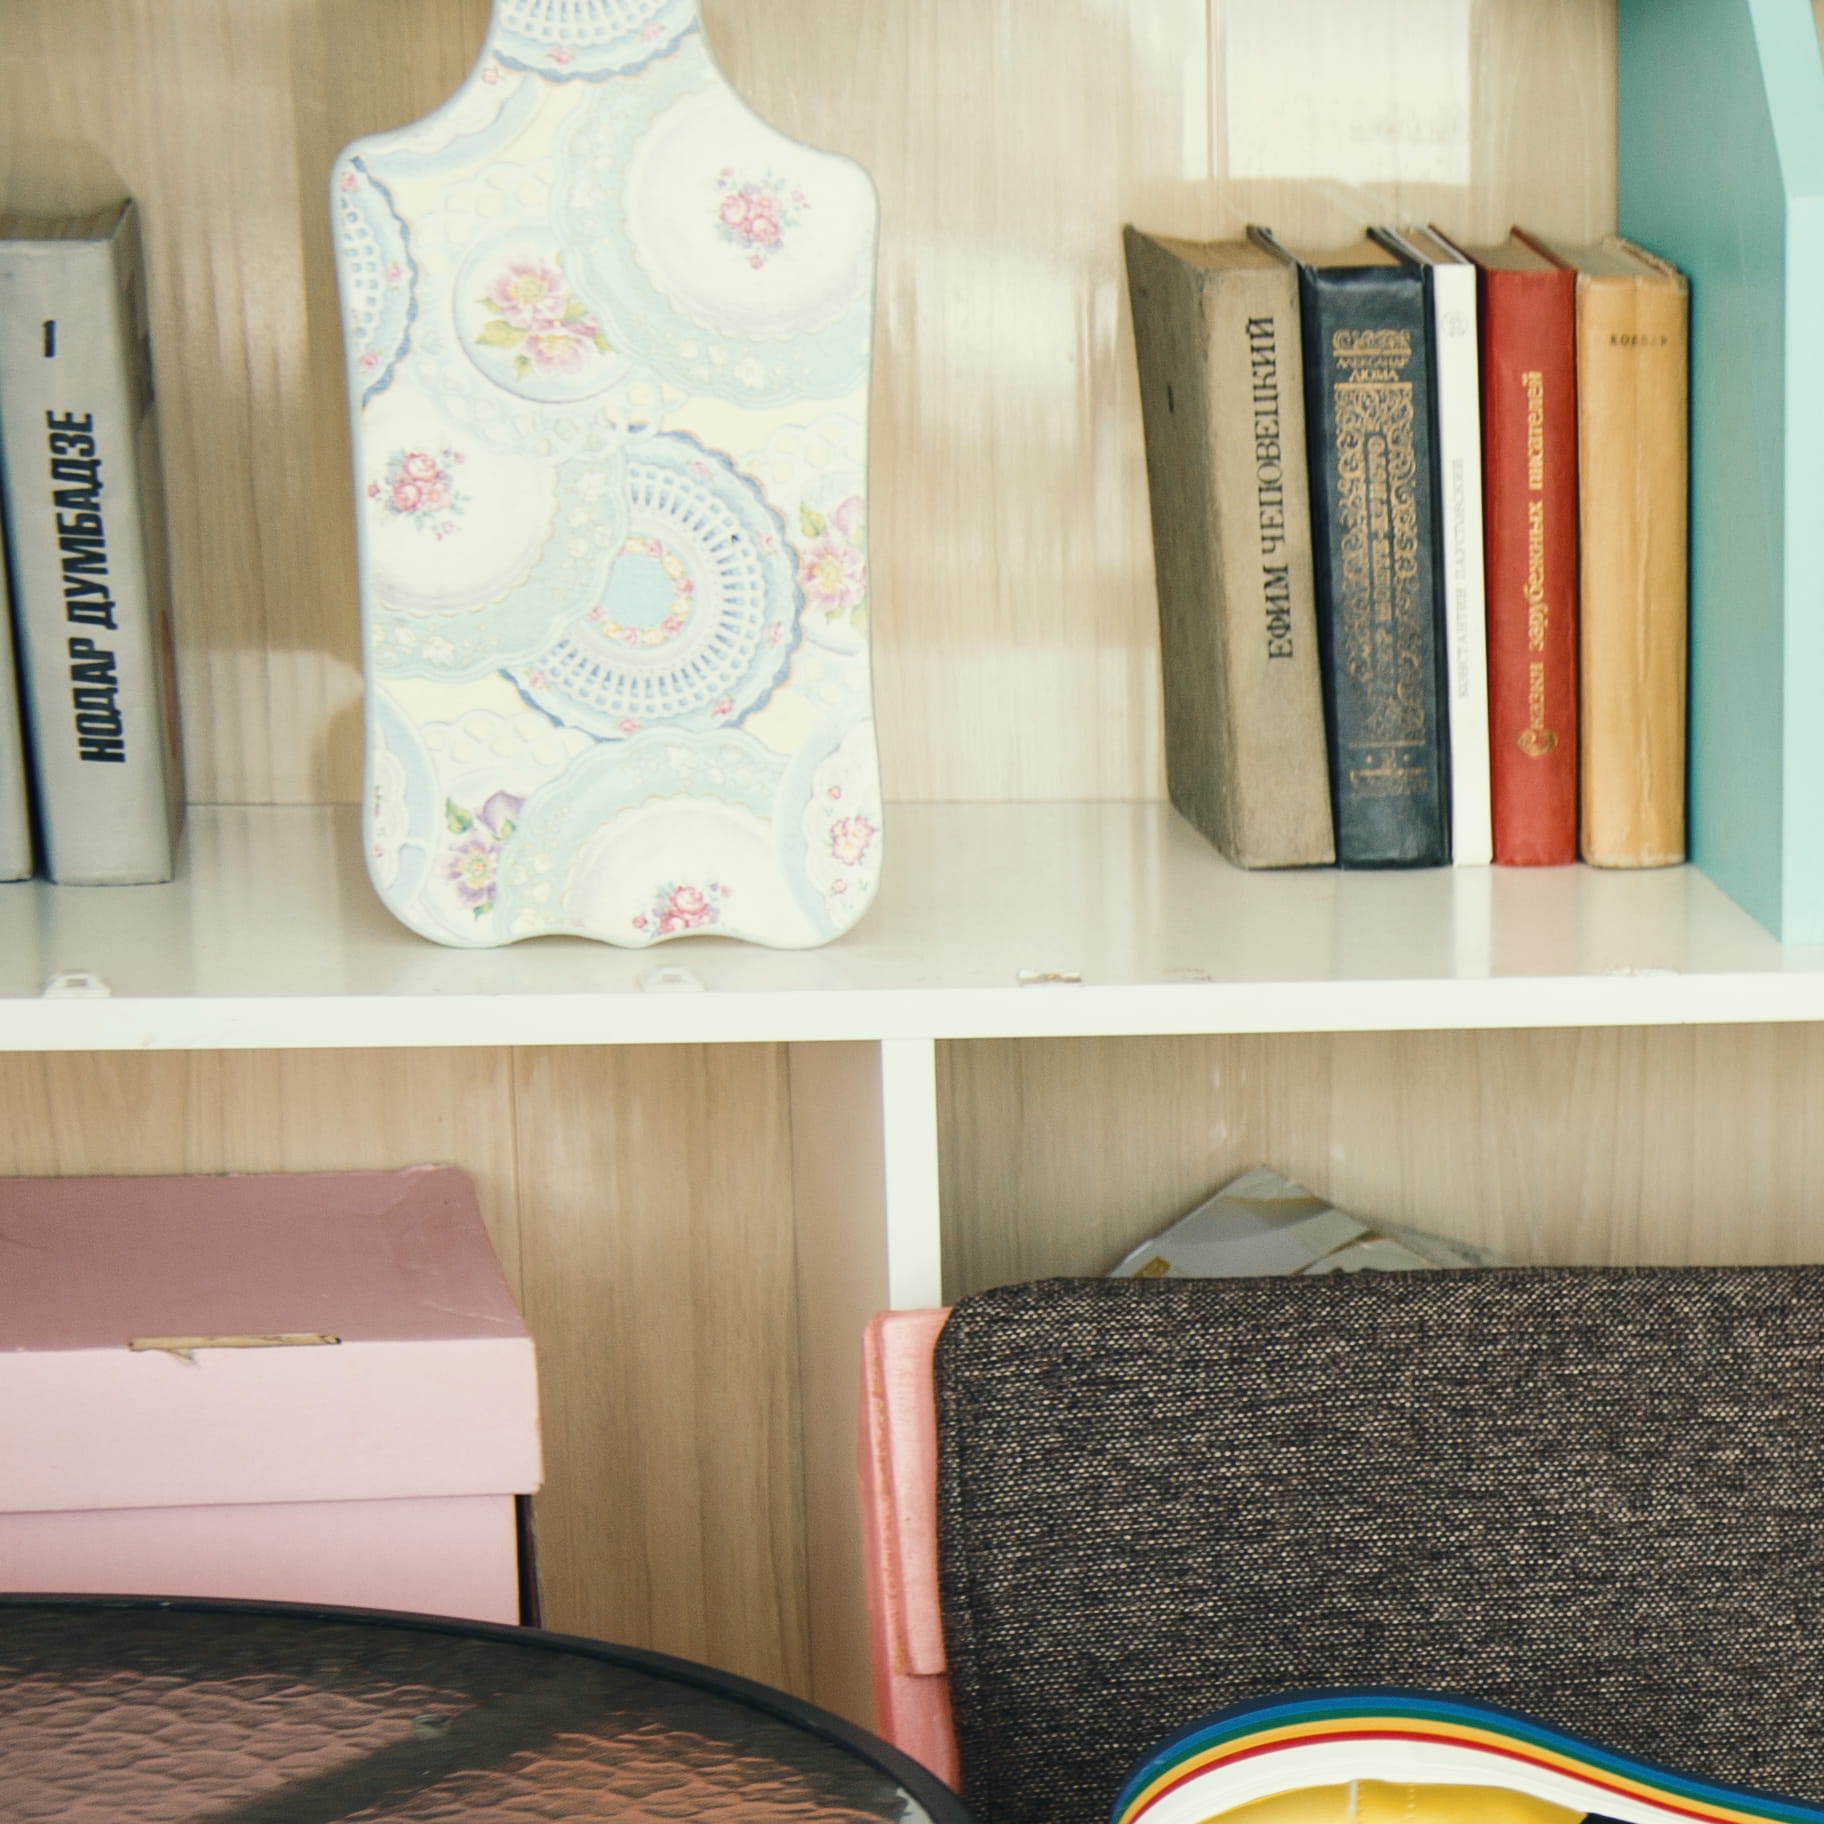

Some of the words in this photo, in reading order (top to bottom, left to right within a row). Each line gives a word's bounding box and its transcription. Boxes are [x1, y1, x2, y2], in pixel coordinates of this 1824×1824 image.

[1247, 316, 1286, 555] ЧЕПОВЕЦКИЙ
[1347, 369, 1399, 383] ДЮМА
[1523, 370, 1544, 491] писателей
[46, 410, 118, 630] ДУМБАДЗЕ
[1524, 500, 1547, 652] зарубежных
[1264, 564, 1294, 660] ЕФИМ
[68, 636, 126, 762] НОДАР
[1516, 662, 1559, 760] Сказки
